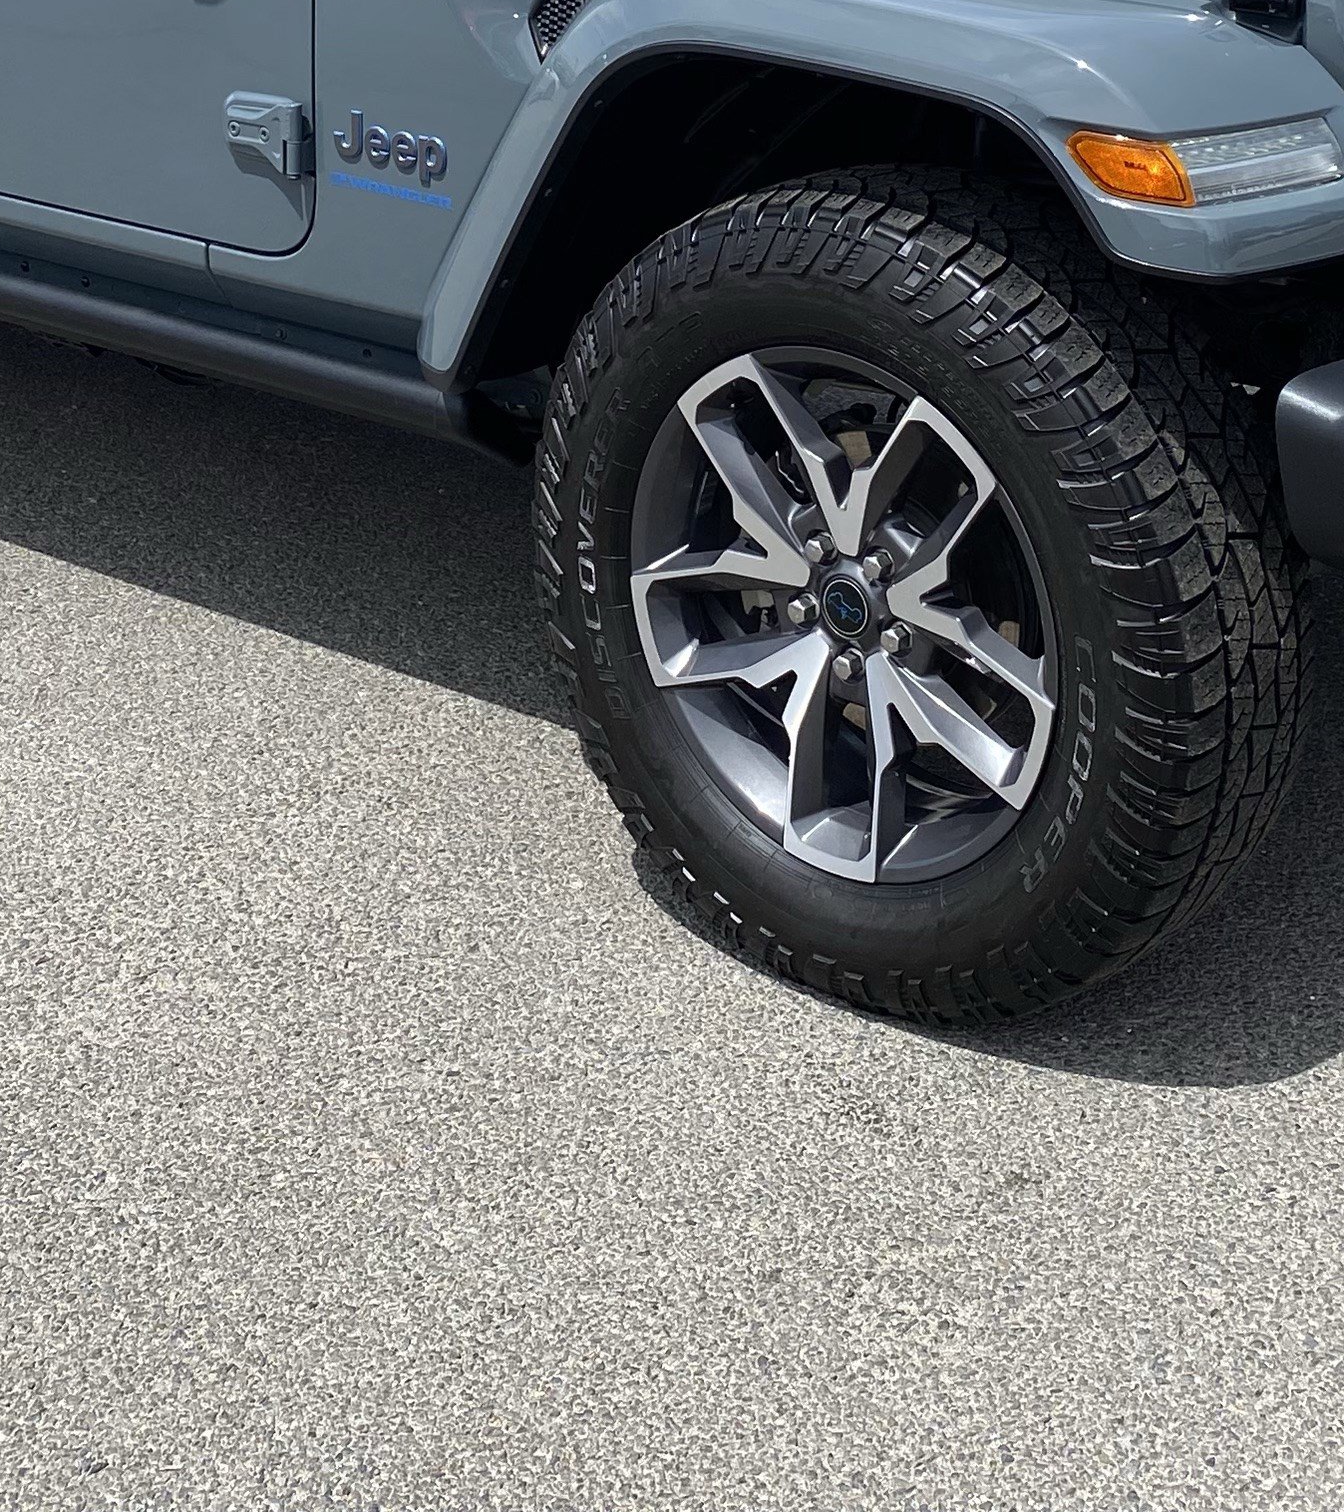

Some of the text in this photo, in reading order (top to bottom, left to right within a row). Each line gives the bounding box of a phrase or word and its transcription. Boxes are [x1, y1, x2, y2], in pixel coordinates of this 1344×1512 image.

[333, 108, 448, 187] Jeep
[576, 386, 633, 721] DISCOVERER
[1018, 633, 1097, 895] COOPER
